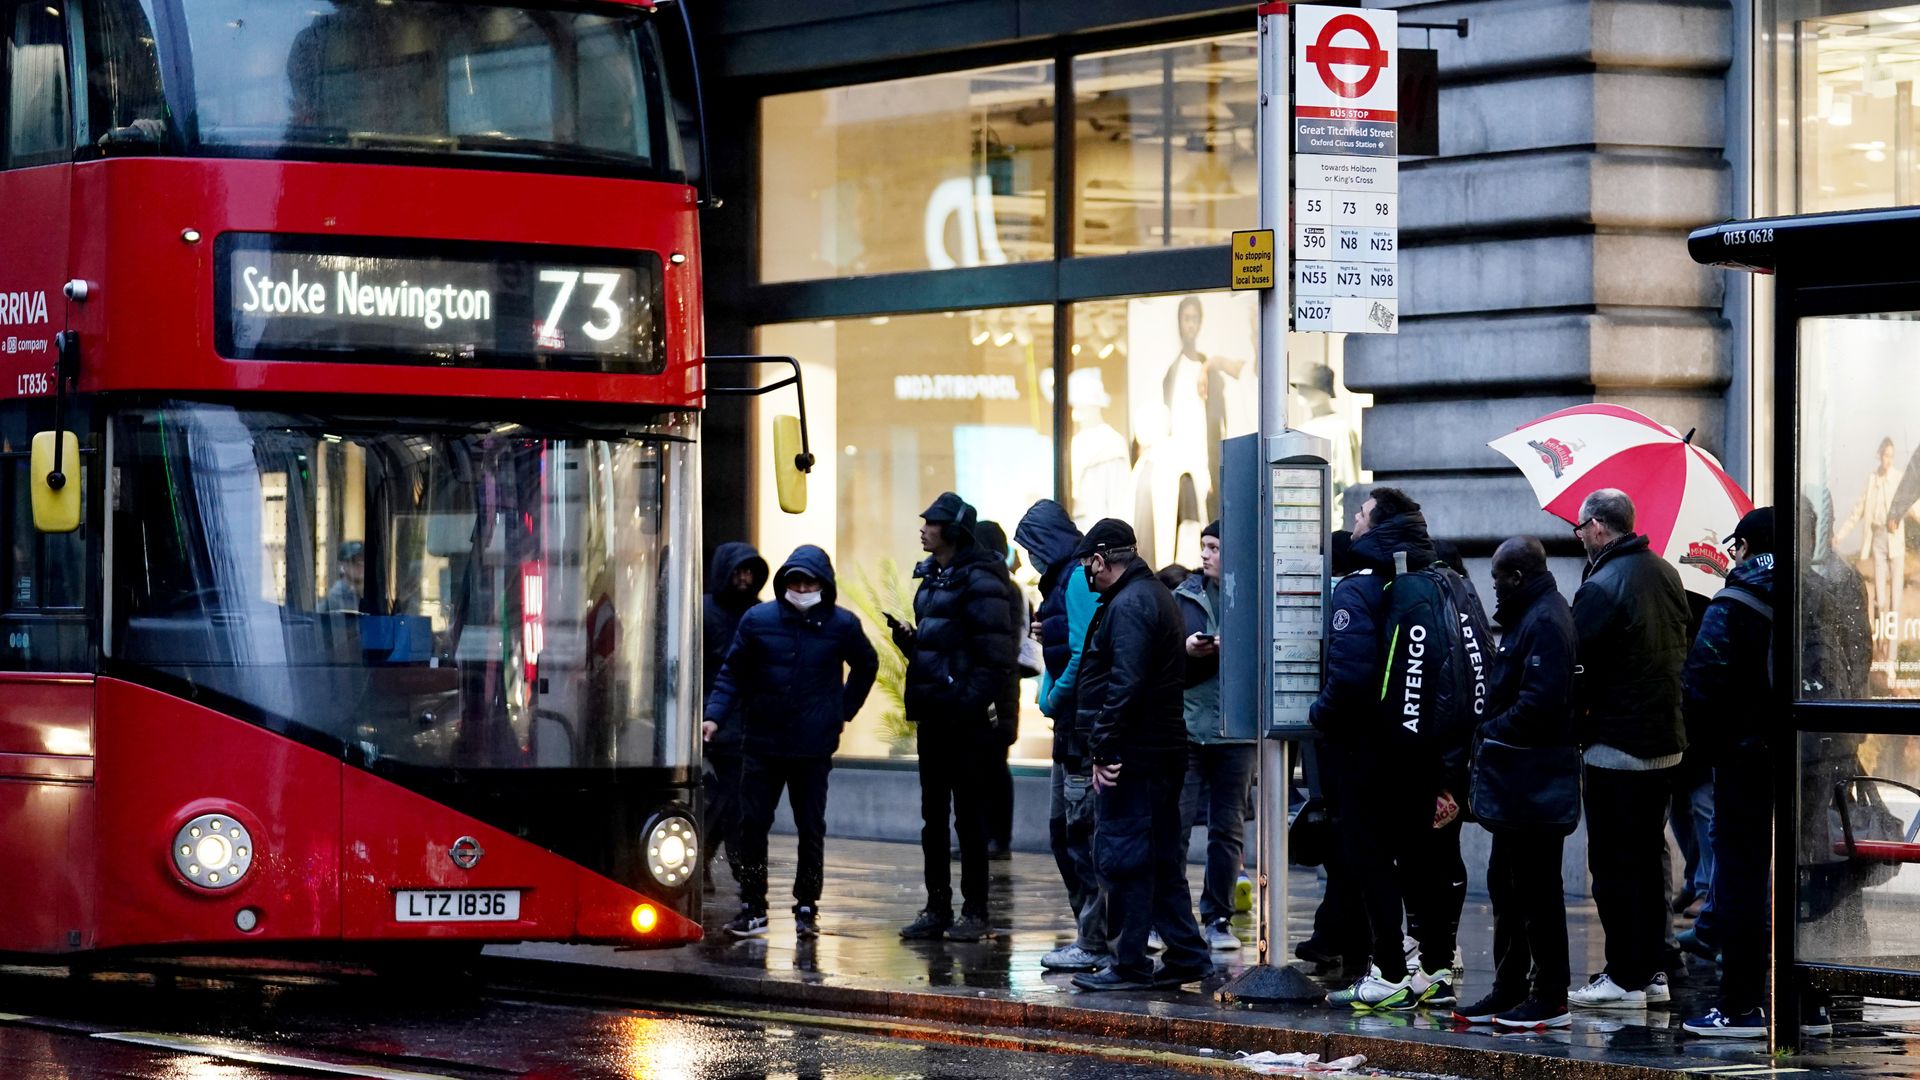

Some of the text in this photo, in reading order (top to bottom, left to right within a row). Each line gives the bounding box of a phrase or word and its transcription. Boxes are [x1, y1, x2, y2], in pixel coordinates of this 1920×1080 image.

[1330, 109, 1369, 119] BUS STOP
[1300, 125, 1394, 138] Great Titchfield Street
[1310, 138, 1377, 148] Oxford Circus Station
[1321, 164, 1376, 173] towards Holborn
[1333, 175, 1354, 184] King's
[1355, 176, 1374, 184] Cross
[1307, 200, 1321, 212] 55
[1343, 202, 1356, 214] 73
[1375, 203, 1389, 216] 98
[1303, 235, 1326, 248] 390
[1341, 237, 1358, 249] N8
[1723, 228, 1774, 245] 0133 0628
[1370, 238, 1393, 251] N25
[1235, 251, 1271, 260] No stopping
[1243, 264, 1263, 273] except
[1236, 275, 1270, 284] local buses
[1302, 272, 1327, 284] N55
[1337, 273, 1361, 285] N73
[1371, 274, 1393, 287] N98
[242, 266, 490, 329] Stoke Newington
[539, 270, 621, 341] 73
[1298, 307, 1331, 320] N207
[2, 340, 6, 351] a
[18, 337, 48, 353] company
[18, 373, 47, 395] LT836
[1459, 612, 1486, 715] ARTENGO
[1402, 625, 1427, 733] ARTENGO
[409, 893, 506, 916] LTZ 1836
